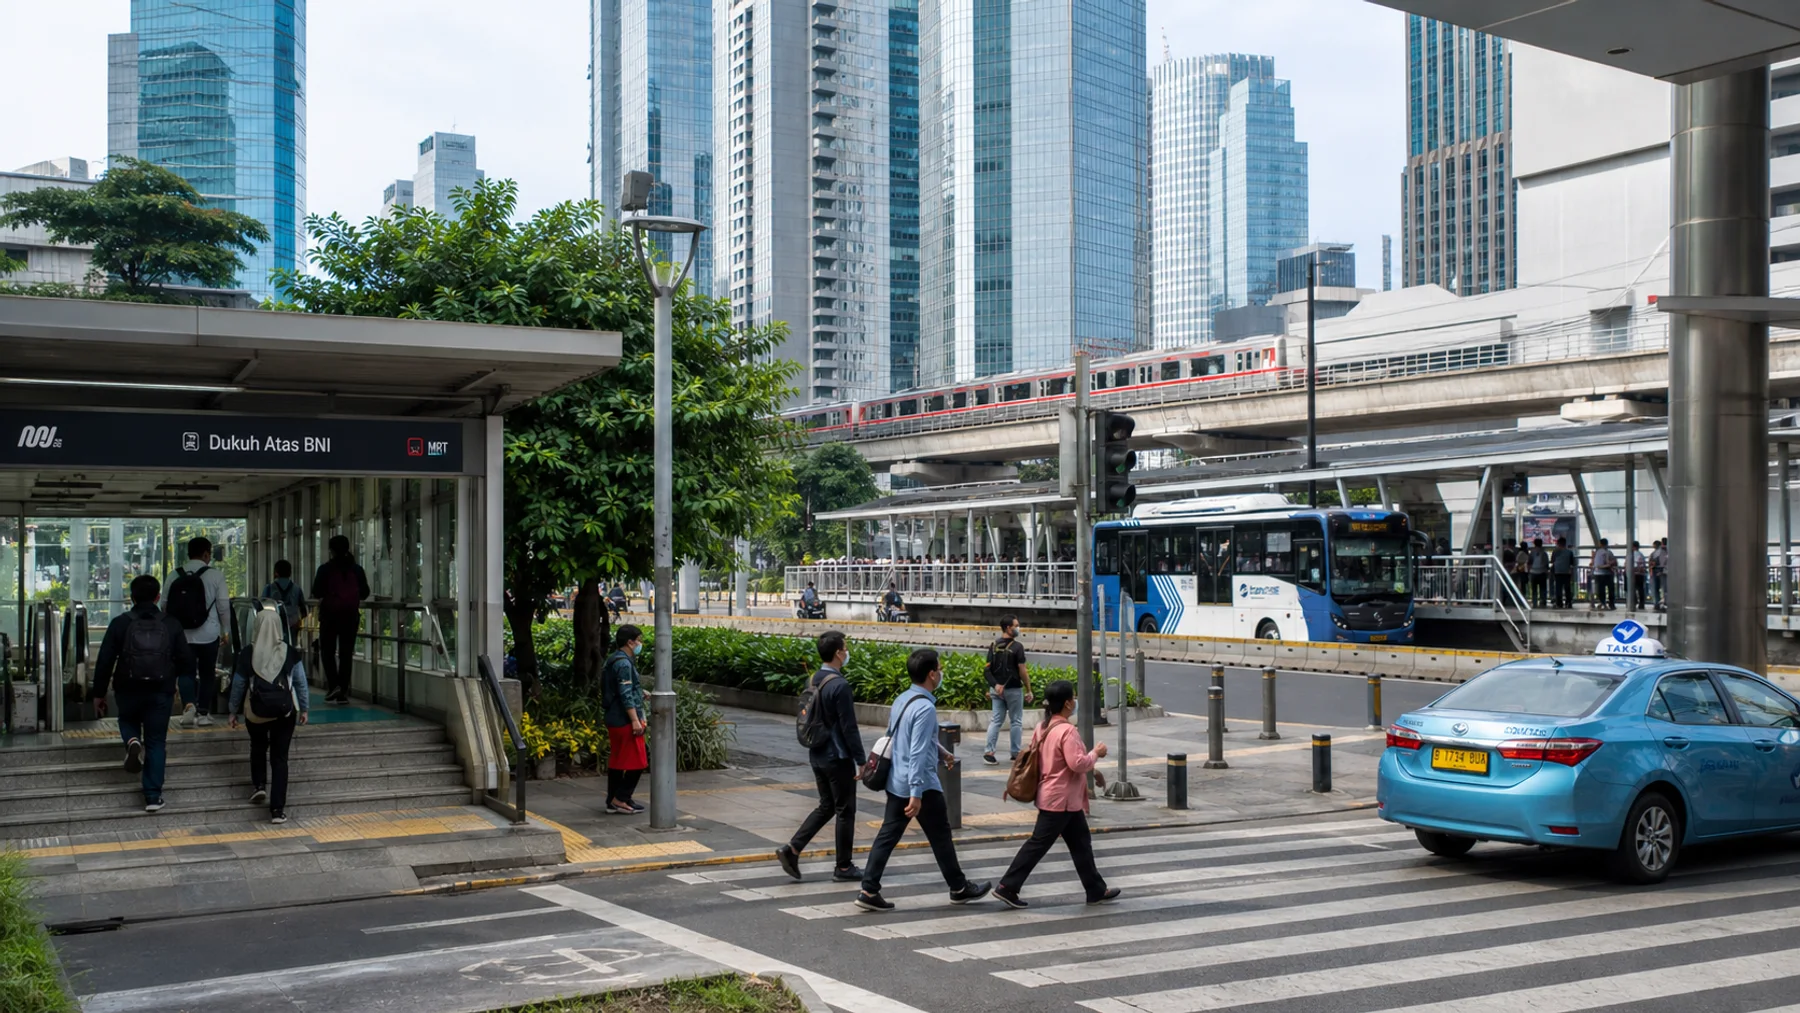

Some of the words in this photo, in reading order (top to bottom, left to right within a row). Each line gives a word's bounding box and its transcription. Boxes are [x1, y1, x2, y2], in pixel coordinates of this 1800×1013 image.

[209, 434, 260, 451] Dukuh
[264, 436, 299, 452] Atas
[304, 437, 331, 453] BNI
[428, 441, 448, 456] MRT
[1606, 644, 1643, 653] TAKSI
